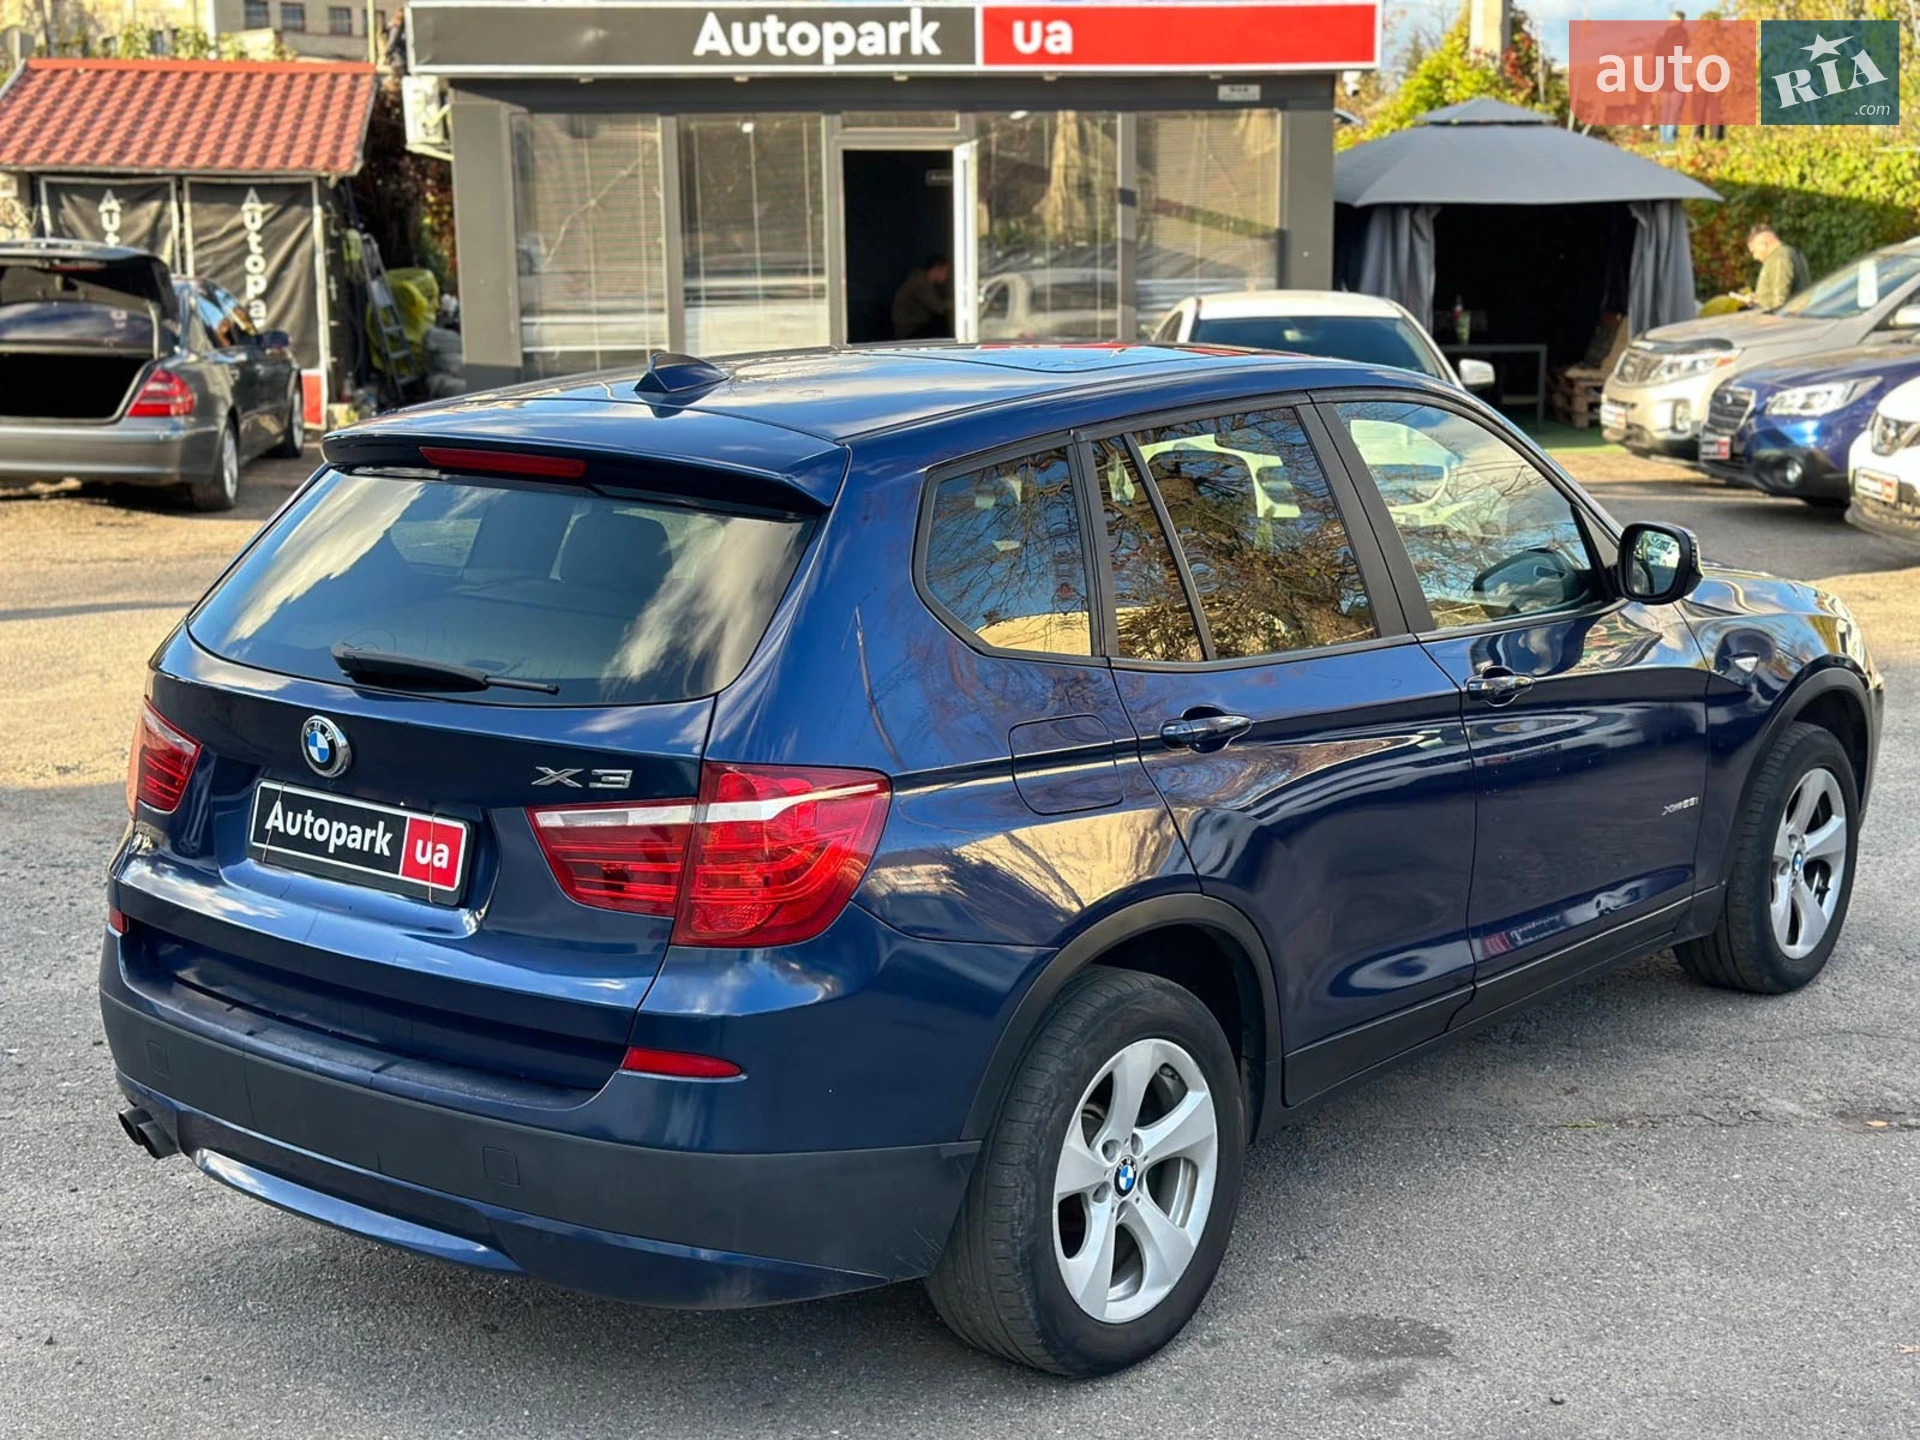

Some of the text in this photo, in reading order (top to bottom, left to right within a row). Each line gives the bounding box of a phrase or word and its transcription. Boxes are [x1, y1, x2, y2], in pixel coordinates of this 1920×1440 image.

[692, 7, 1074, 66] Autopark ua
[531, 766, 633, 789] X3
[265, 800, 450, 869] Autopark ua
